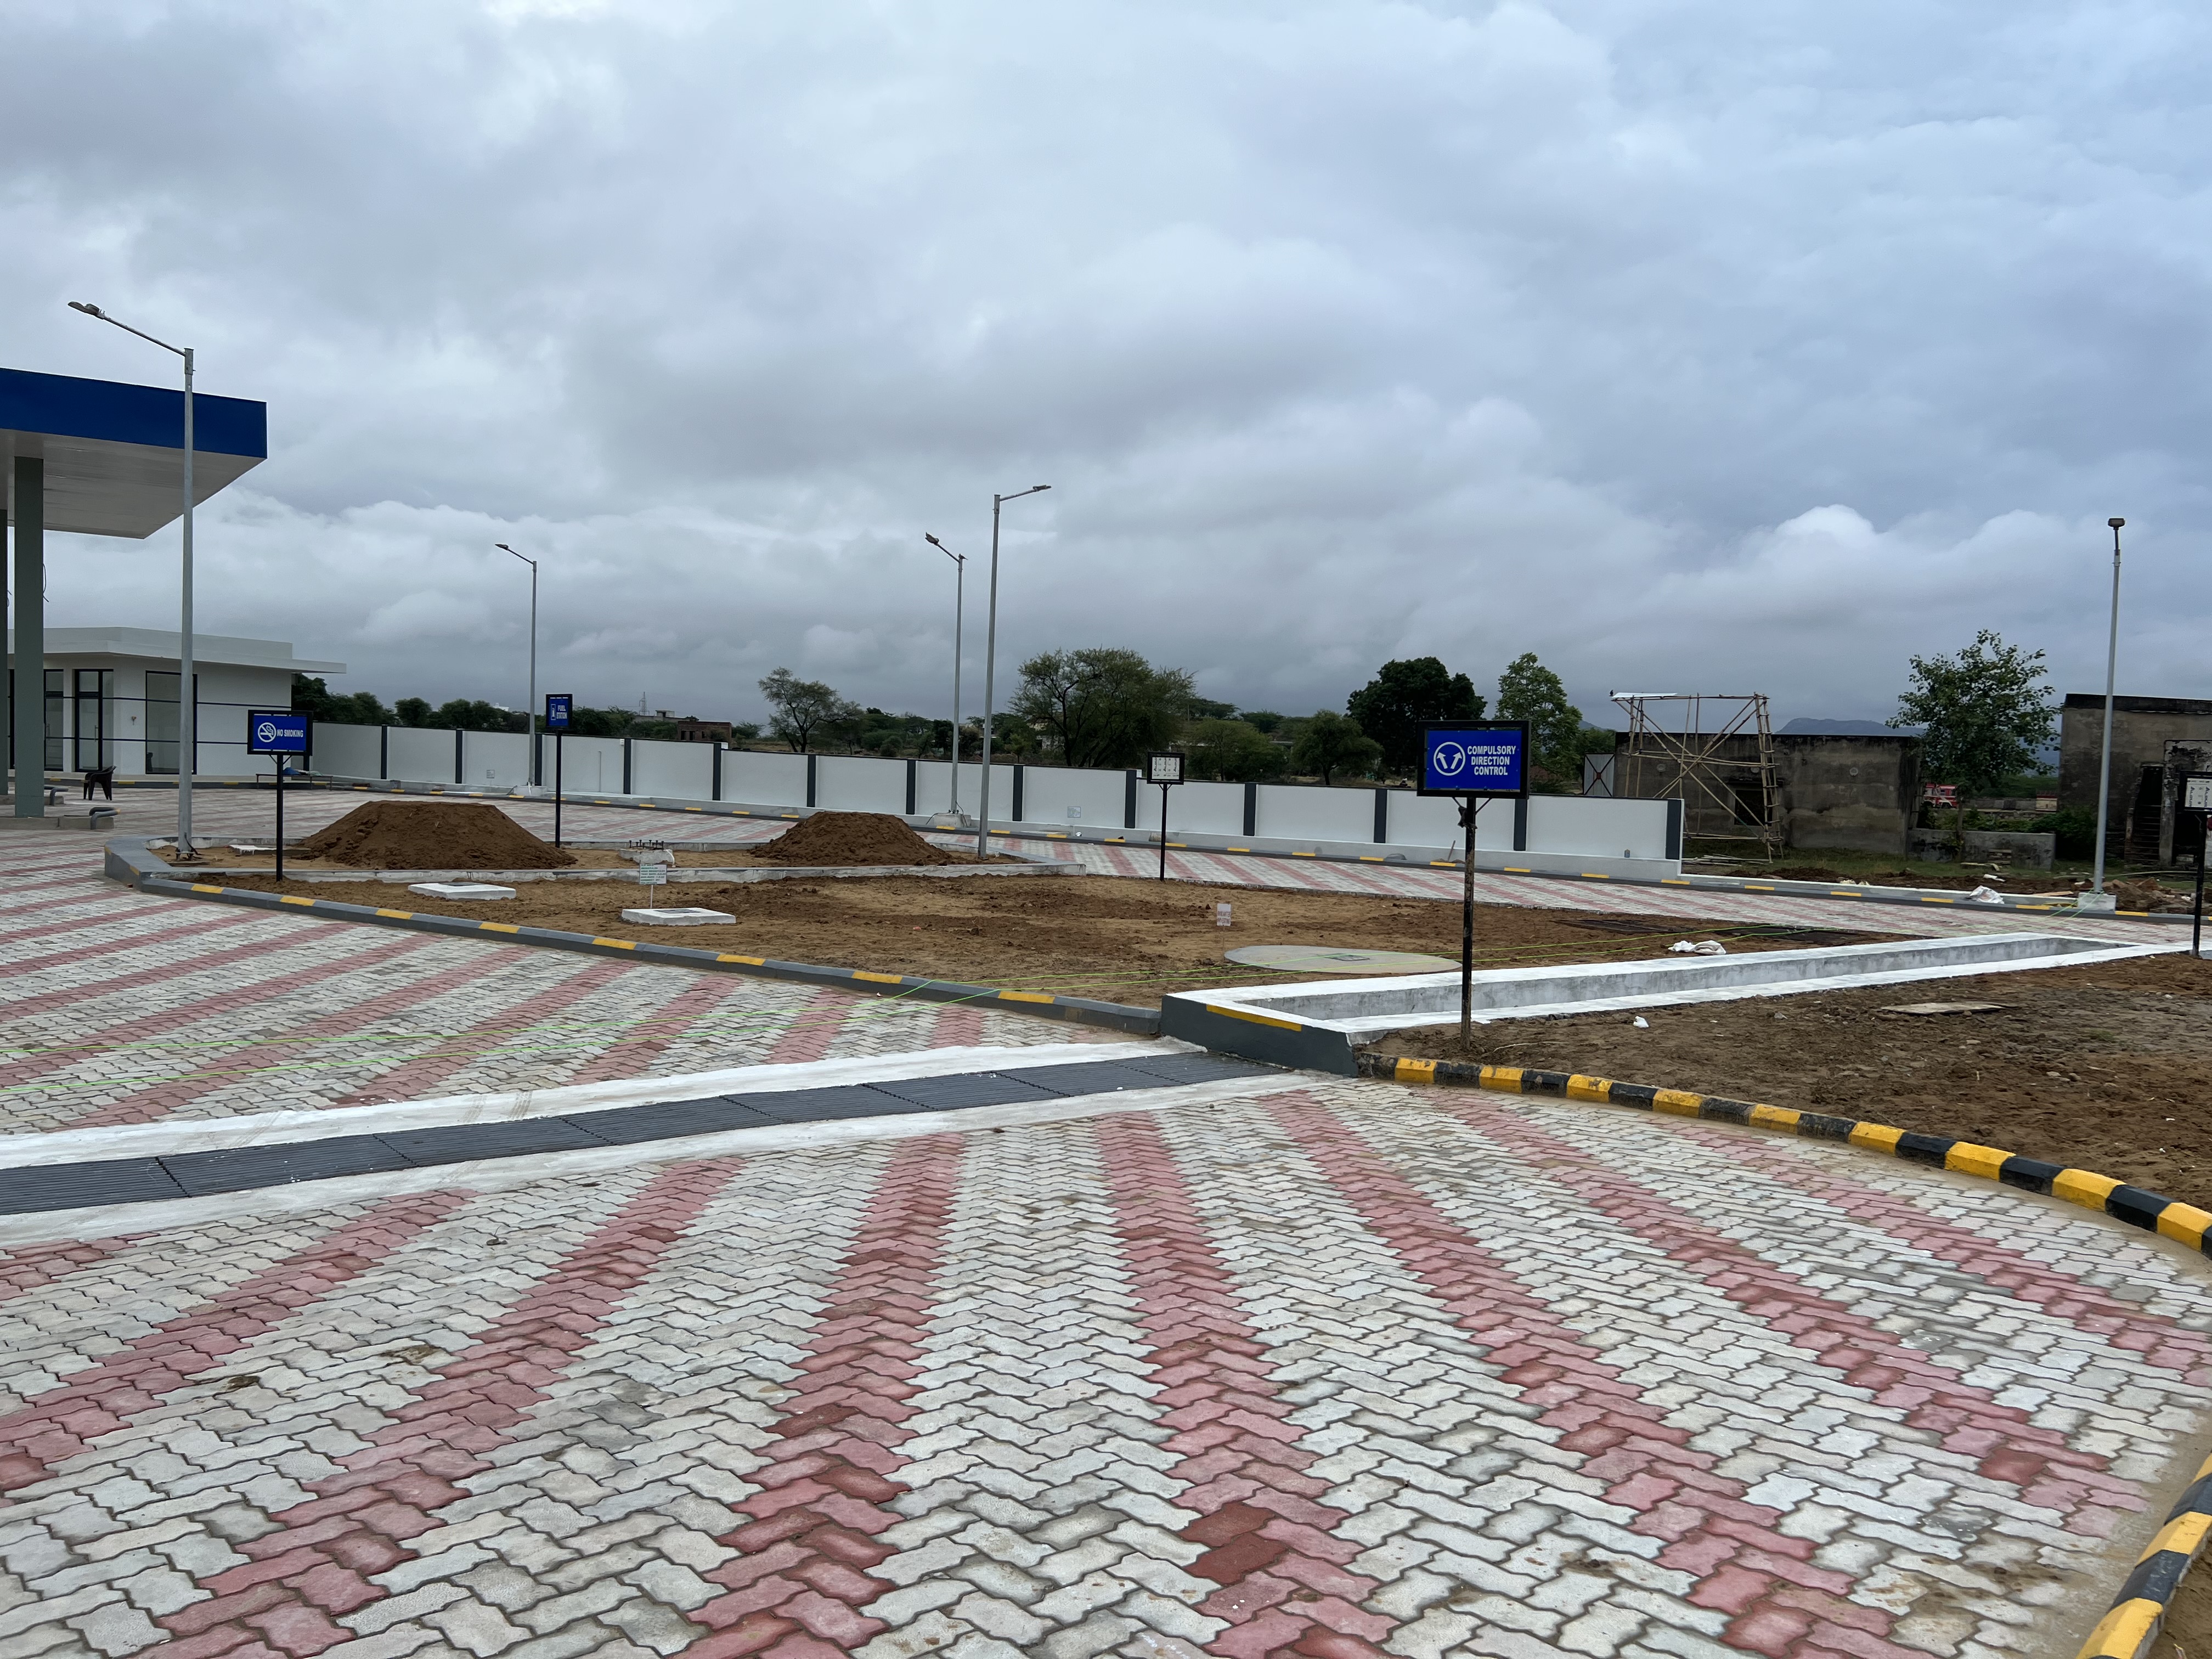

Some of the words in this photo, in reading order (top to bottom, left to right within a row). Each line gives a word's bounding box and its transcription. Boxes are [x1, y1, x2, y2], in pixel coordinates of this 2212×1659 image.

[284, 729, 303, 737] SMOKING
[1467, 745, 1516, 755] COMPULSORY
[1471, 756, 1510, 765] DIRECTION
[1474, 766, 1508, 775] CONTROL
